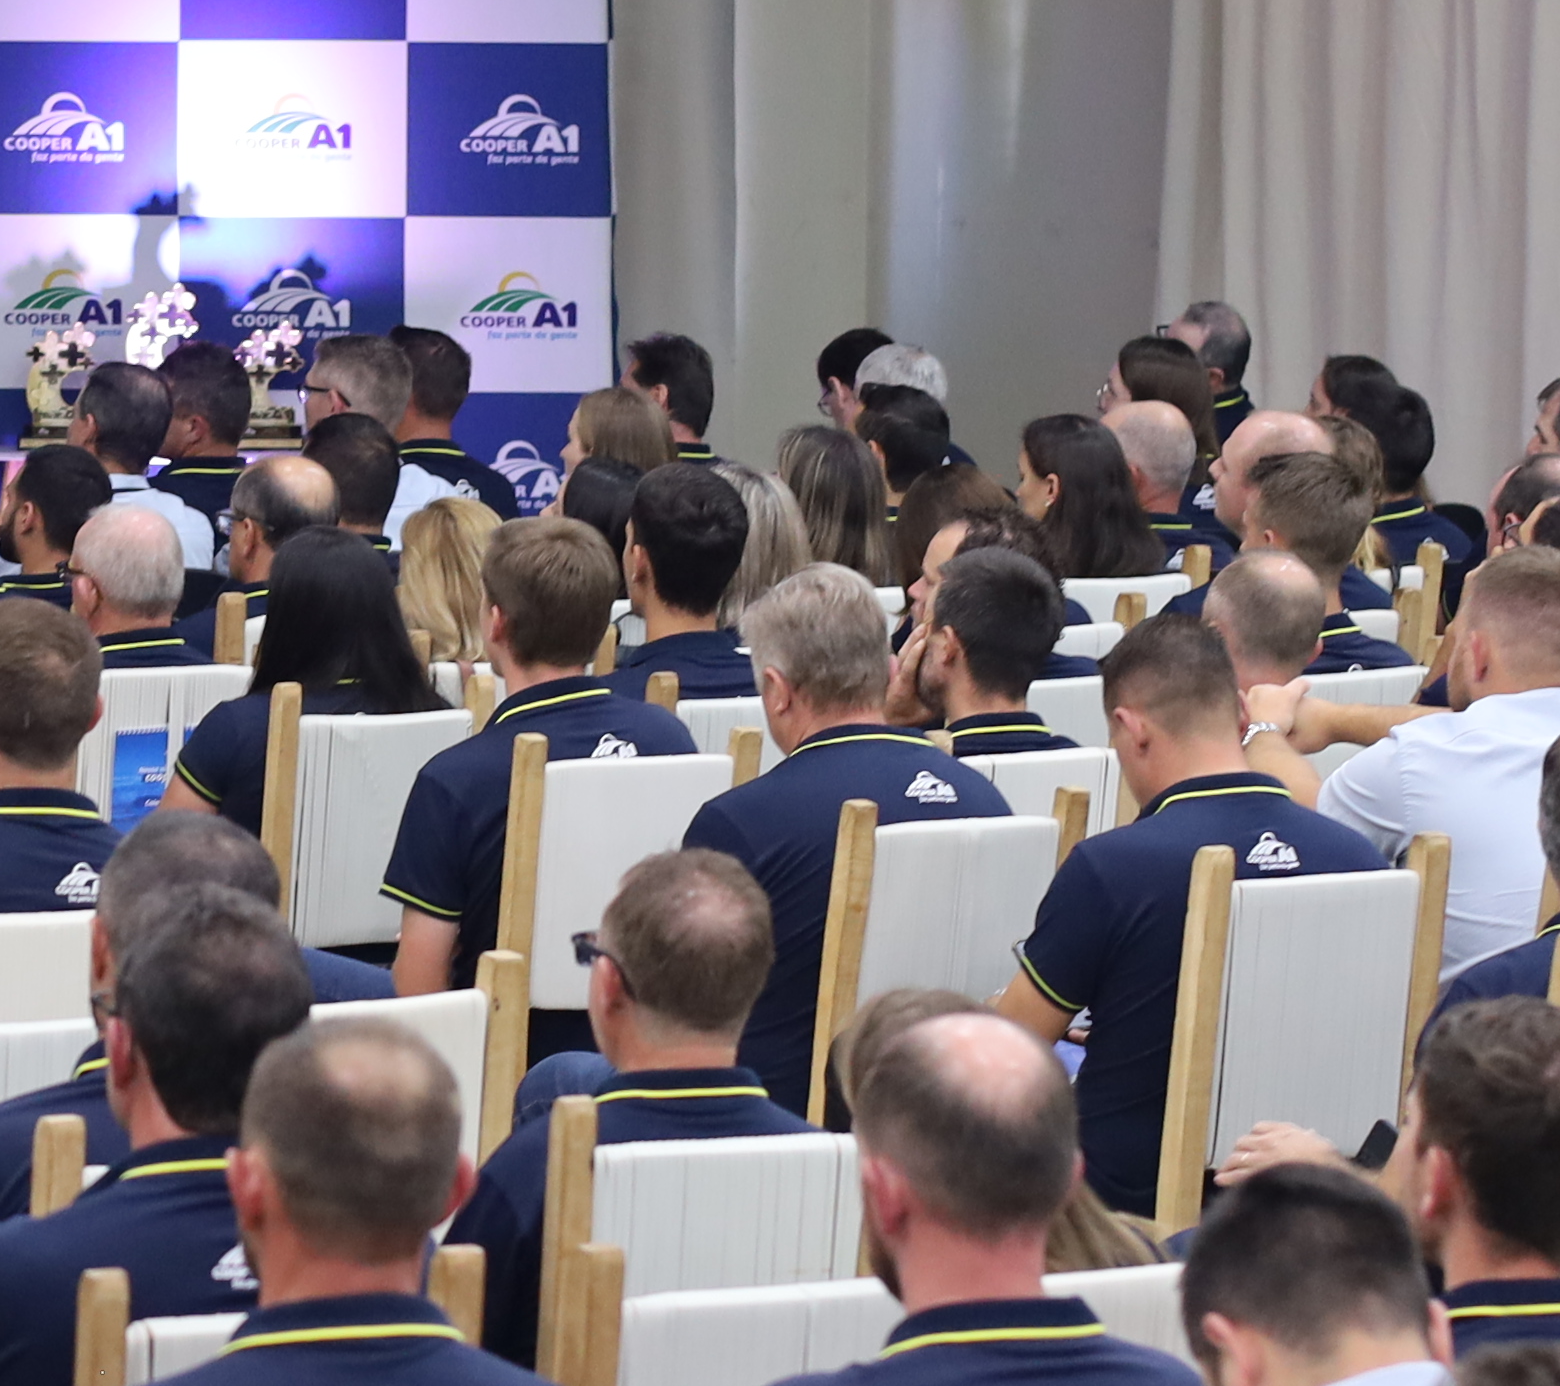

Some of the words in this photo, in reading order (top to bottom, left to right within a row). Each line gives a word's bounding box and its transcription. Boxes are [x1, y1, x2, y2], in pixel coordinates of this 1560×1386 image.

[3, 136, 72, 151] COOPER
[76, 122, 124, 151] A1
[308, 123, 352, 149] A1
[460, 138, 528, 153] COOPER
[531, 124, 580, 153] A1
[4, 311, 70, 325] COOPER
[77, 299, 122, 325] A1
[232, 313, 299, 327] COOPER
[304, 299, 350, 327] A1
[460, 316, 525, 328] COOPER
[532, 302, 577, 327] A1
